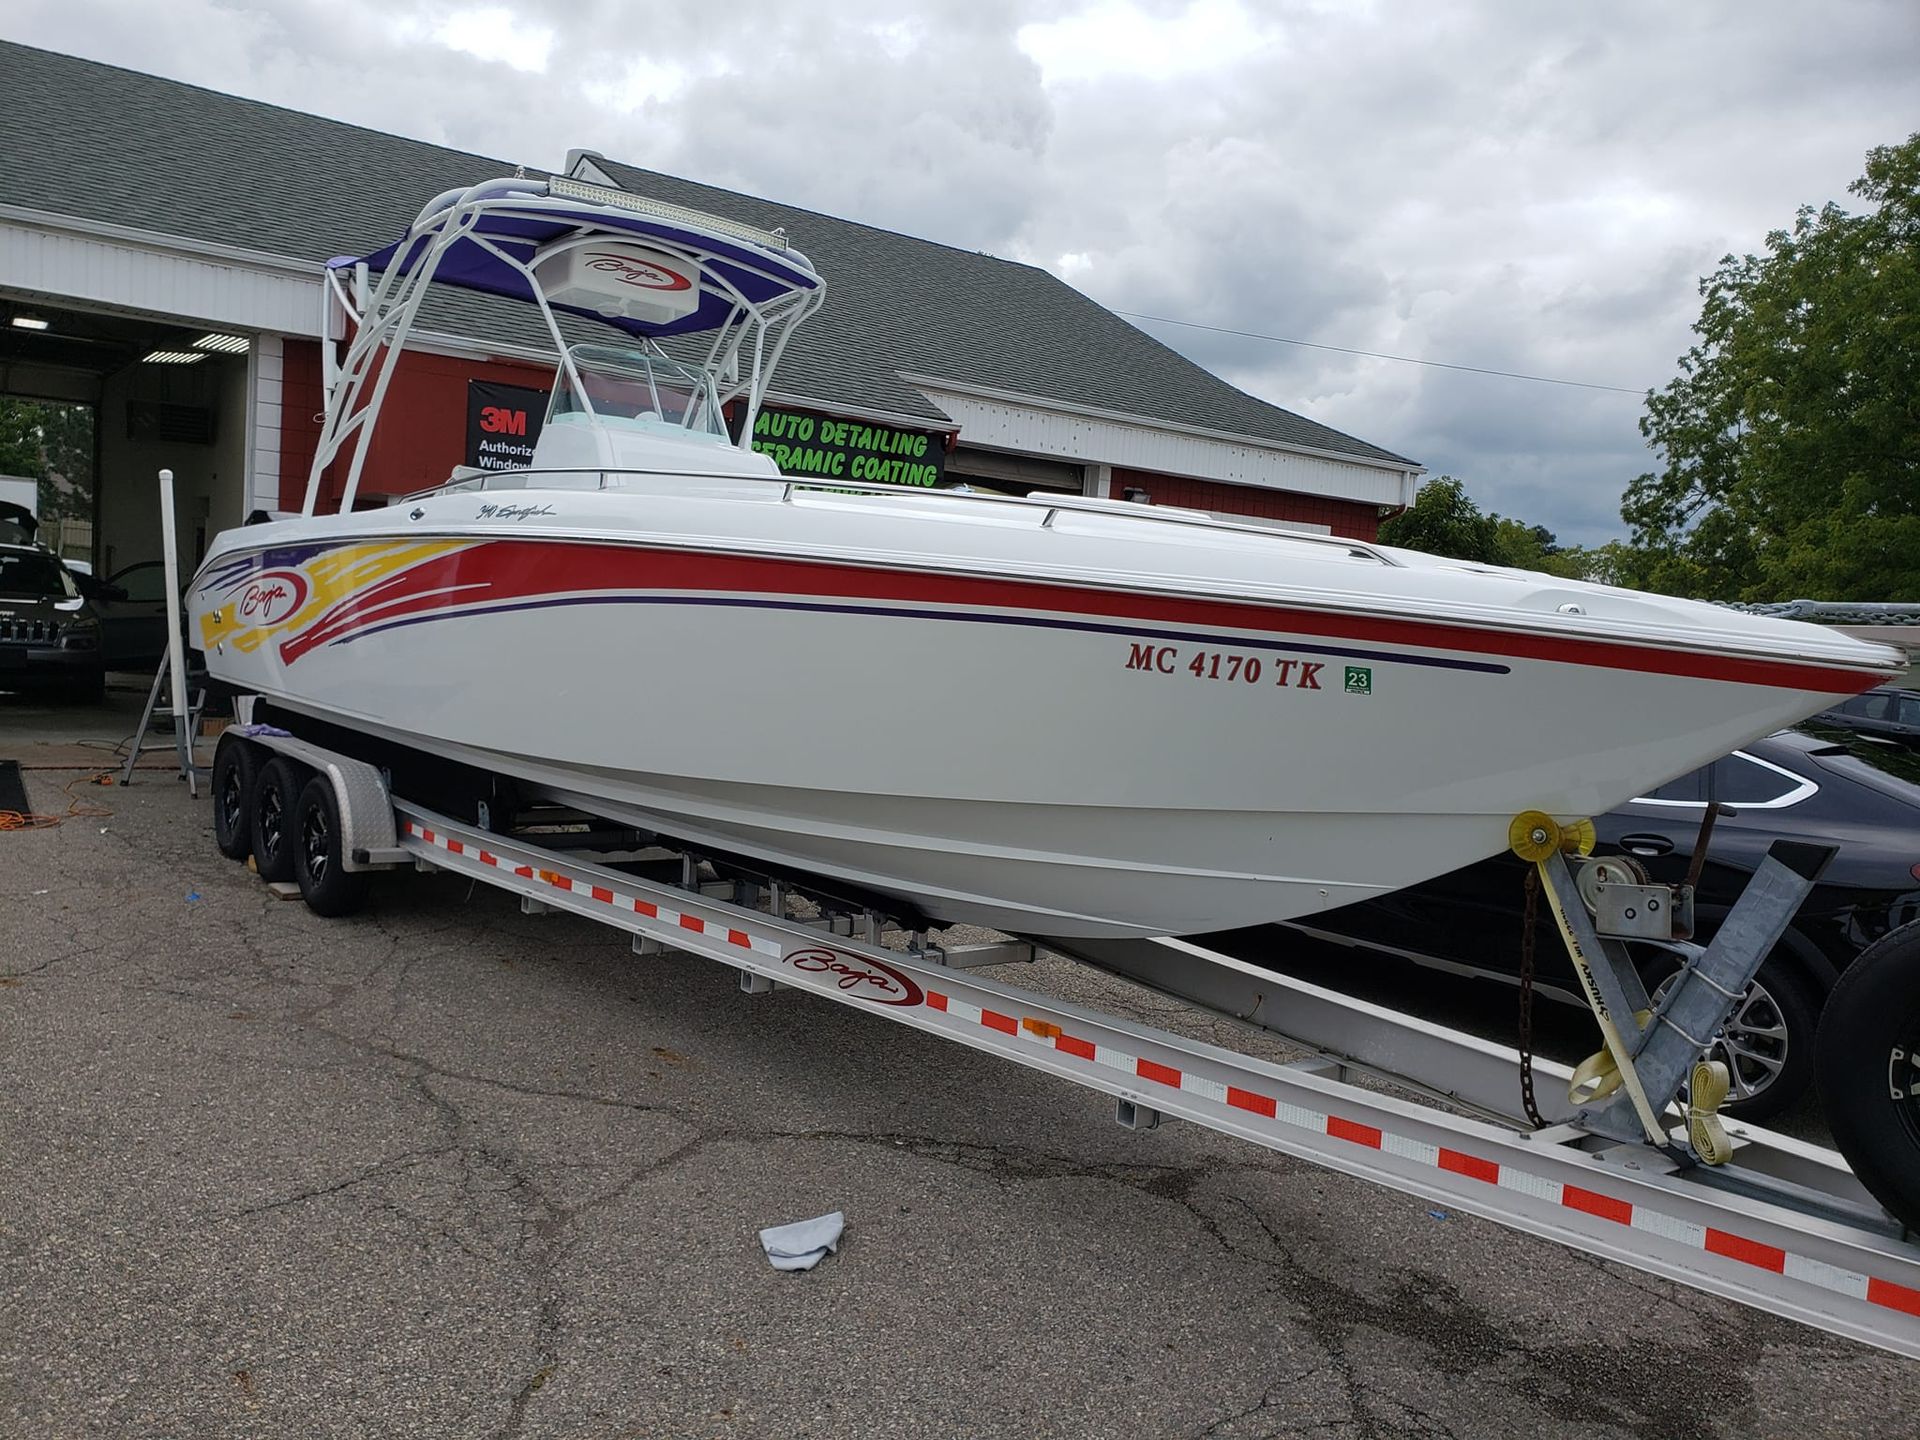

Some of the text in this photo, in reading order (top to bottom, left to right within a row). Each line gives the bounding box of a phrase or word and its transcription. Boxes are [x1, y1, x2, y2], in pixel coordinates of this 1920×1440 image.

[584, 258, 664, 281] Baja
[480, 406, 527, 436] 3M
[754, 411, 928, 458] AUTO DETAILING
[479, 456, 531, 470] Window
[850, 455, 938, 488] COATING
[240, 584, 288, 618] Baja
[1125, 643, 1325, 690] MC 4170 TK
[1348, 672, 1368, 687] 23
[782, 949, 899, 989] Baja
[1580, 963, 1605, 1008] HUSKY
